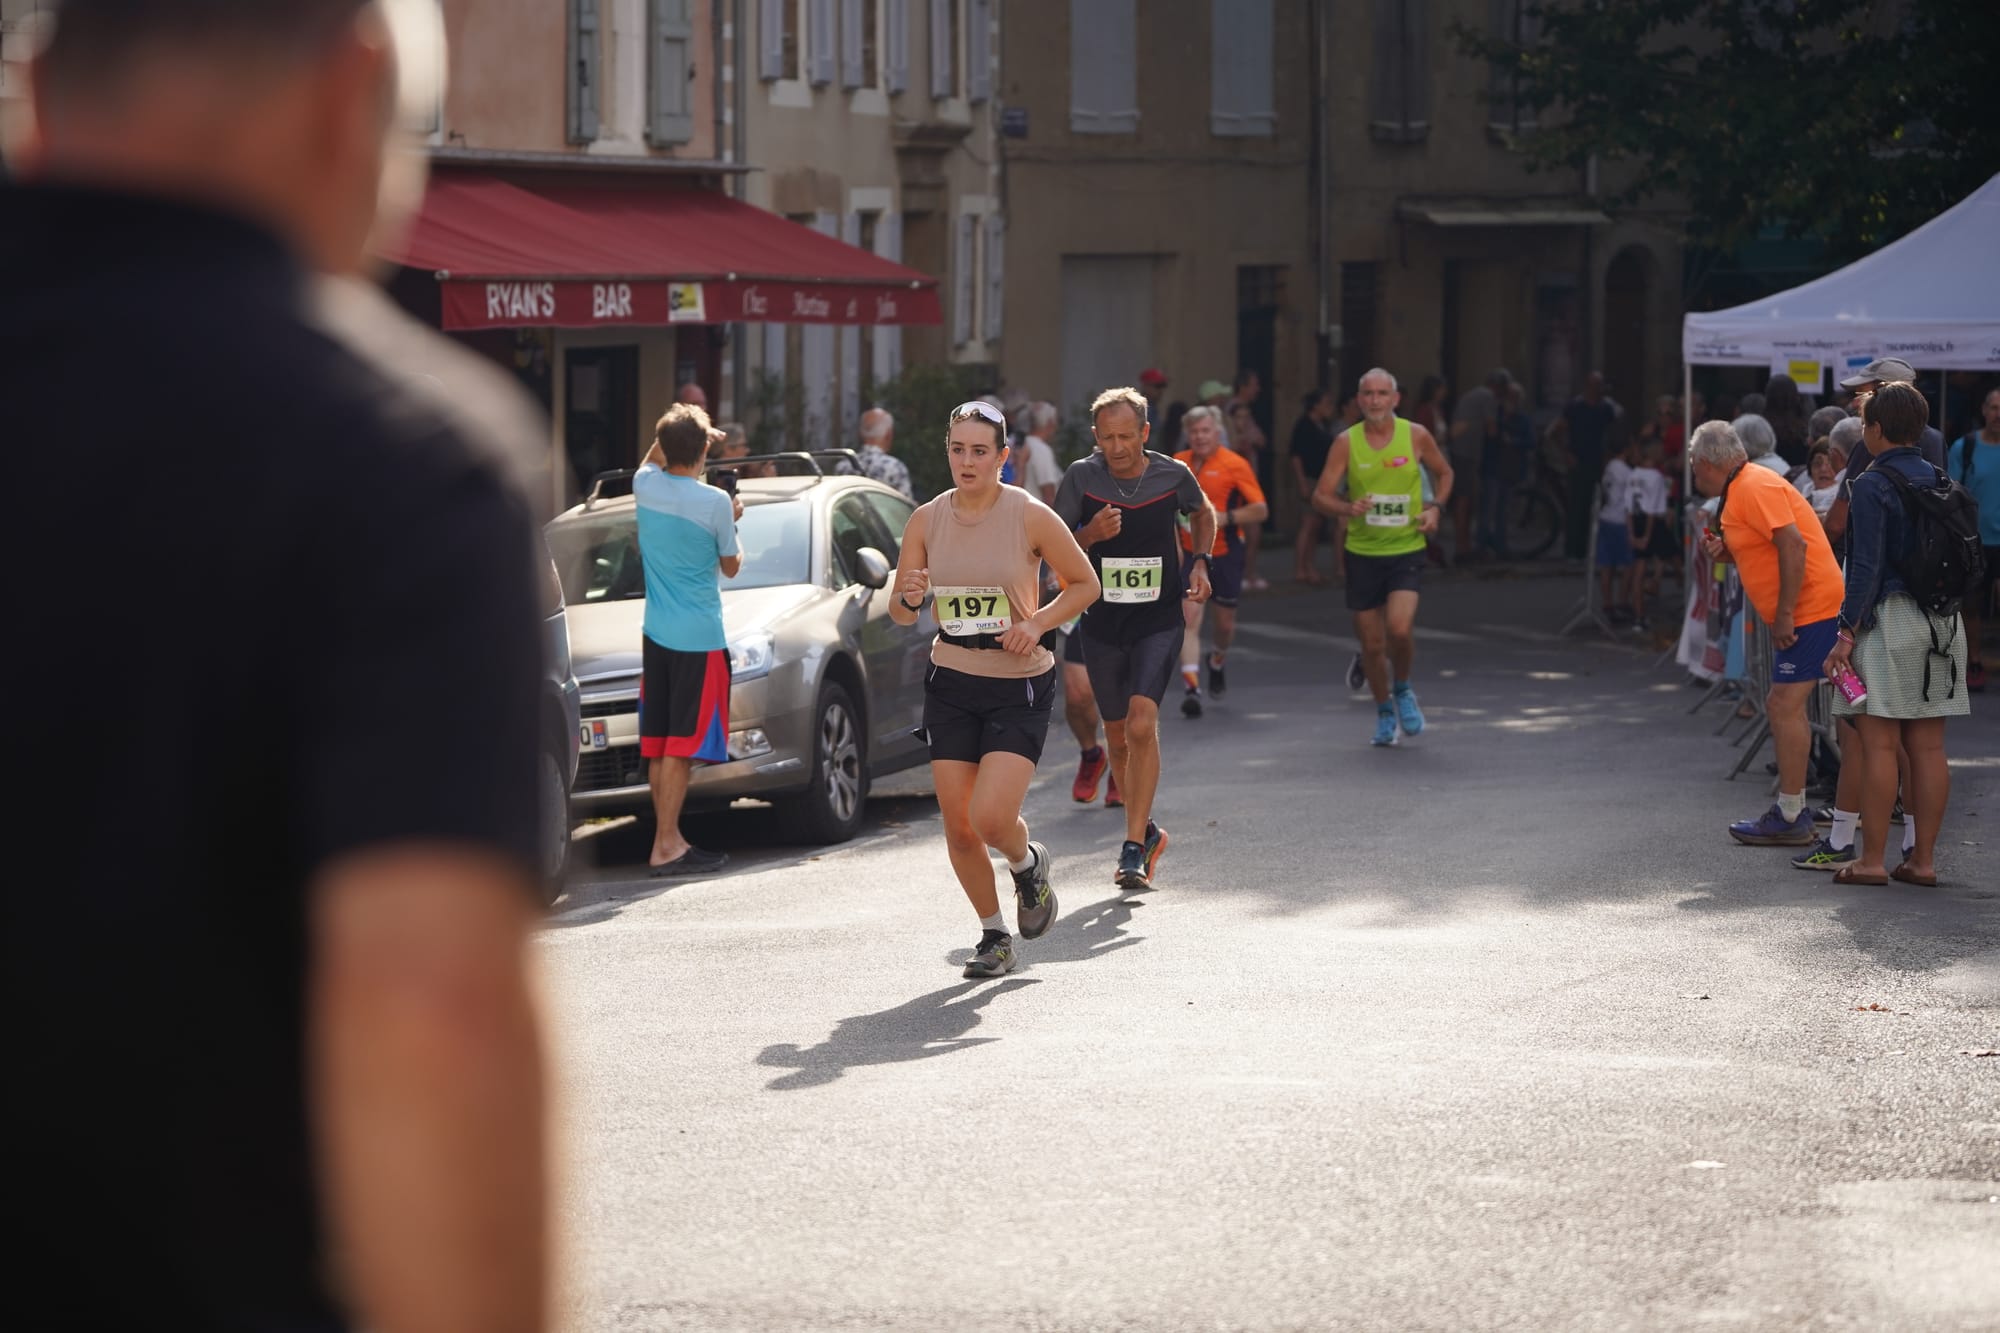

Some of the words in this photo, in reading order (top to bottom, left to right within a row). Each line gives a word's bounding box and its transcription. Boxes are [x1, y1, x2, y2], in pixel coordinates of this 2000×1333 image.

[486, 283, 555, 319] RYAN'S
[592, 284, 633, 317] BAR
[1375, 502, 1404, 516] 154
[1111, 569, 1152, 588] 161
[948, 596, 998, 618] 197
